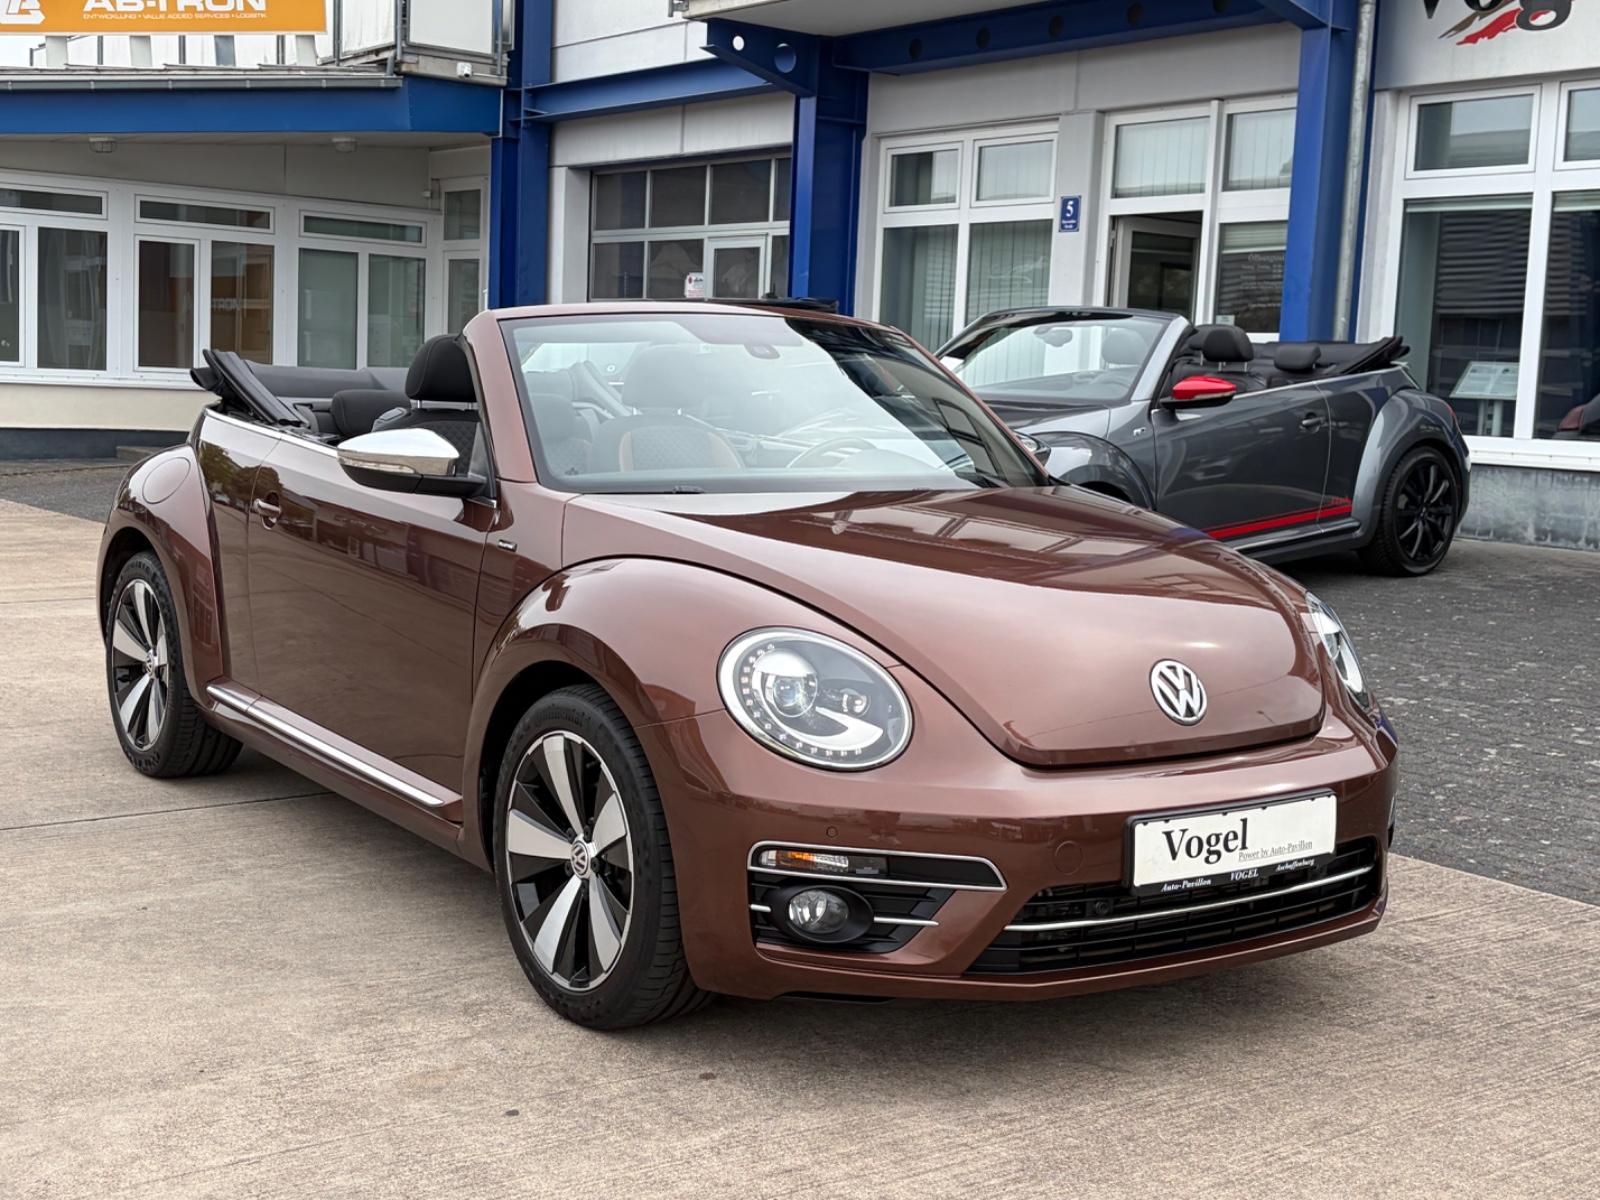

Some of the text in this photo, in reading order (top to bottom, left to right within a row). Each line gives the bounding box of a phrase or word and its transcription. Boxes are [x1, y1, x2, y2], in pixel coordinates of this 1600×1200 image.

[1065, 200, 1074, 217] 5
[1162, 817, 1249, 866] Vogel
[1229, 868, 1259, 882] VOGEL
